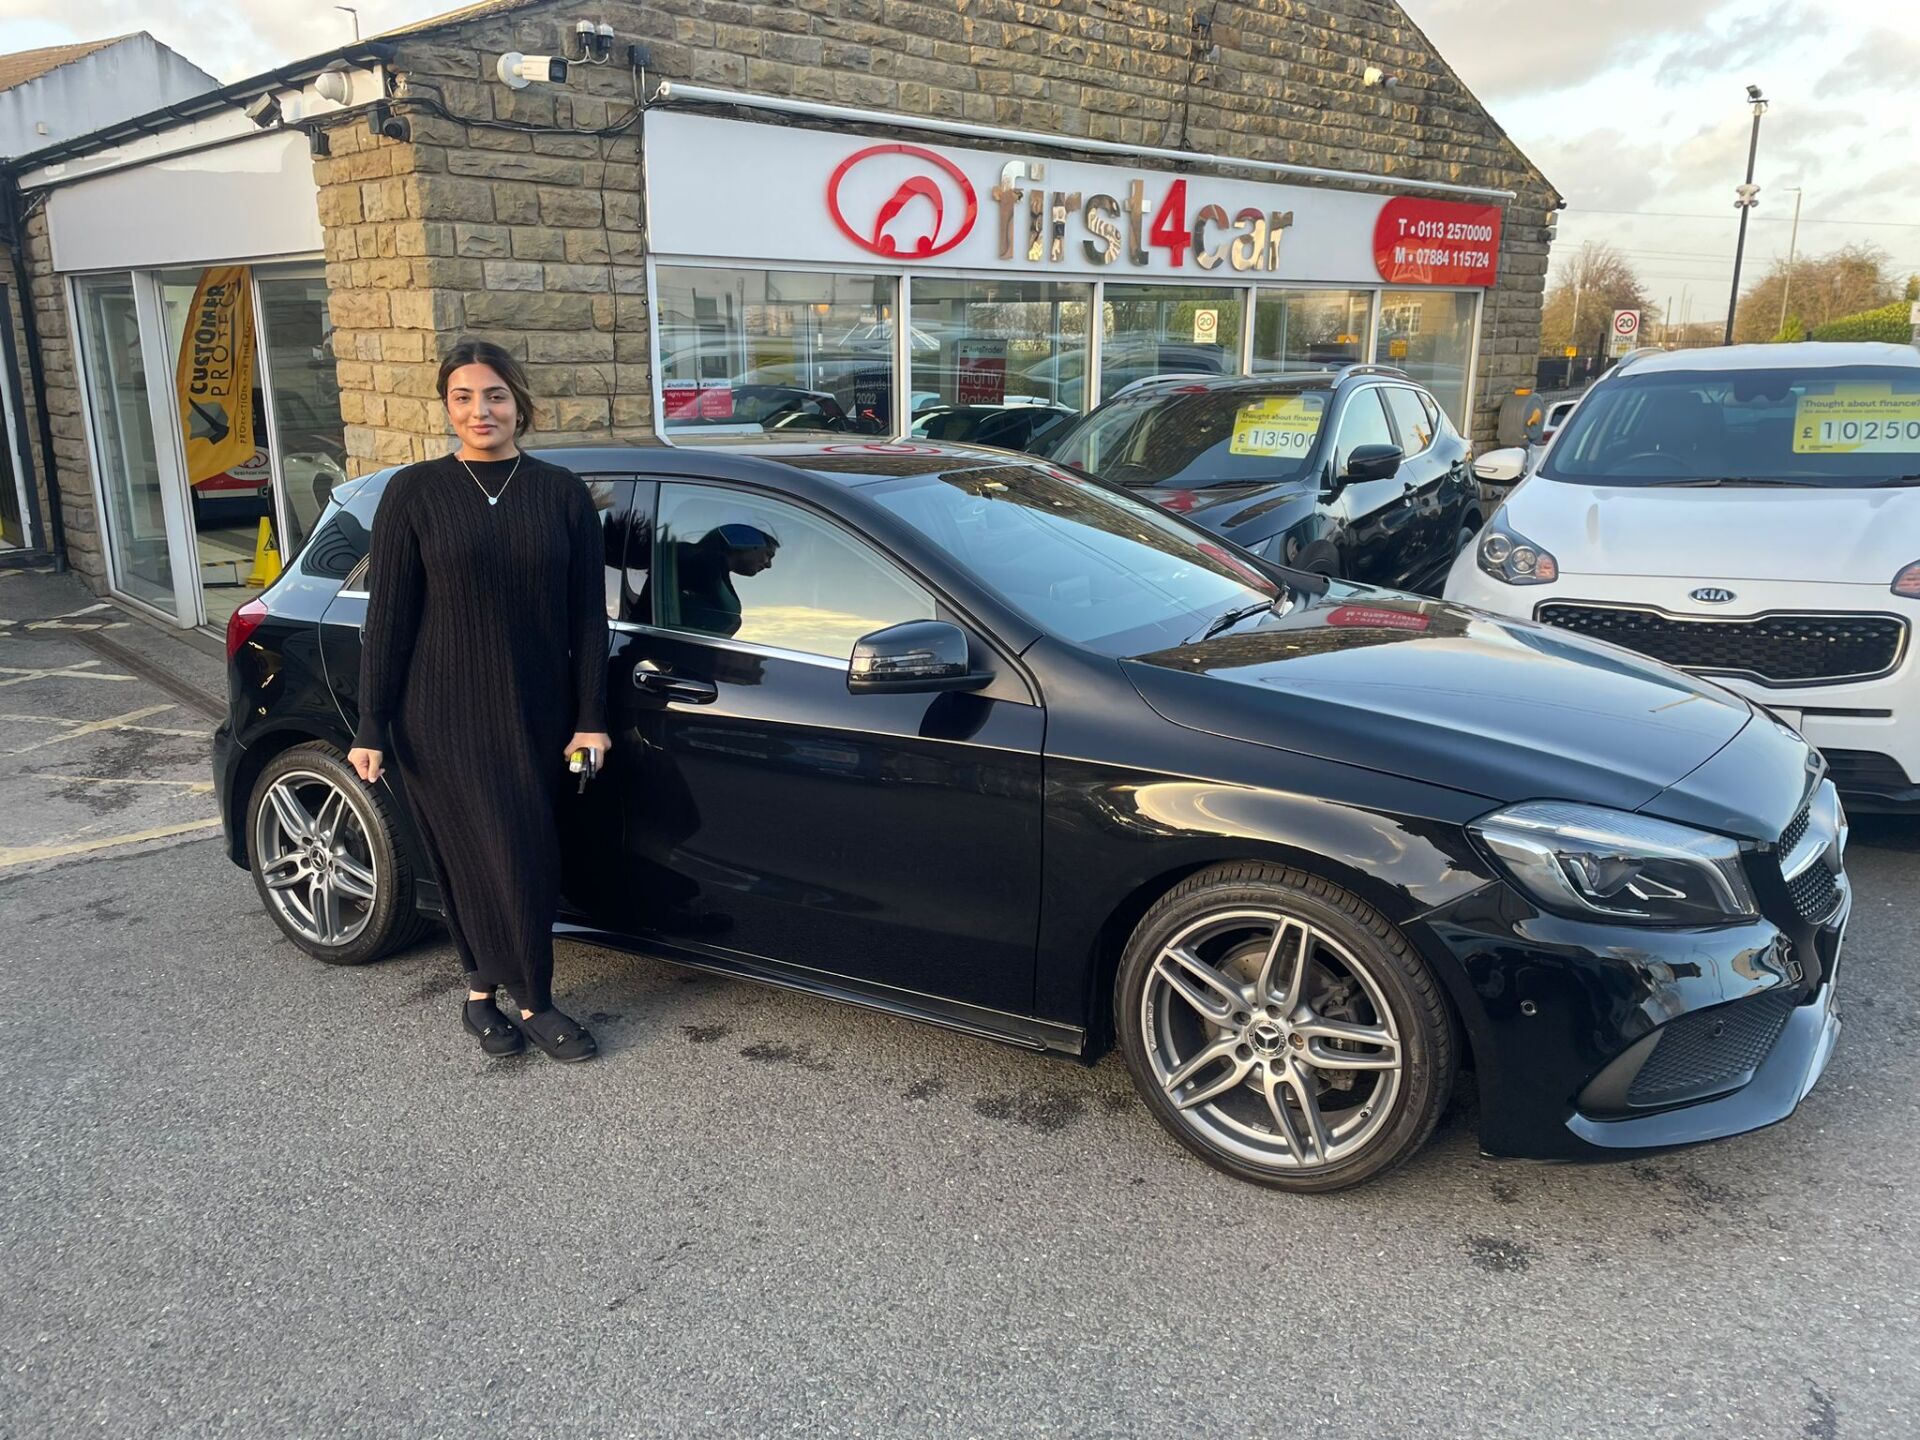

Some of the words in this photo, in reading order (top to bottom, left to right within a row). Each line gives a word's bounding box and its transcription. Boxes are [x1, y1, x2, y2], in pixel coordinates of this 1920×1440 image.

[992, 160, 1294, 272] first4car
[1398, 218, 1408, 236] T
[1418, 221, 1444, 238] 0113
[1447, 223, 1492, 241] 2570000
[1395, 246, 1406, 263] M
[1416, 248, 1449, 266] 07884
[1453, 251, 1489, 268] 115724
[1200, 318, 1212, 326] 20
[1619, 318, 1633, 328] 20
[189, 284, 226, 395] CUSTOMER
[855, 379, 887, 390] Awards
[961, 368, 1002, 390] Highly
[856, 393, 877, 405] 2022
[960, 392, 999, 403] Rated
[1804, 400, 1844, 408] Thought
[1823, 421, 1920, 440] 10250
[1696, 589, 1729, 601] KIA
